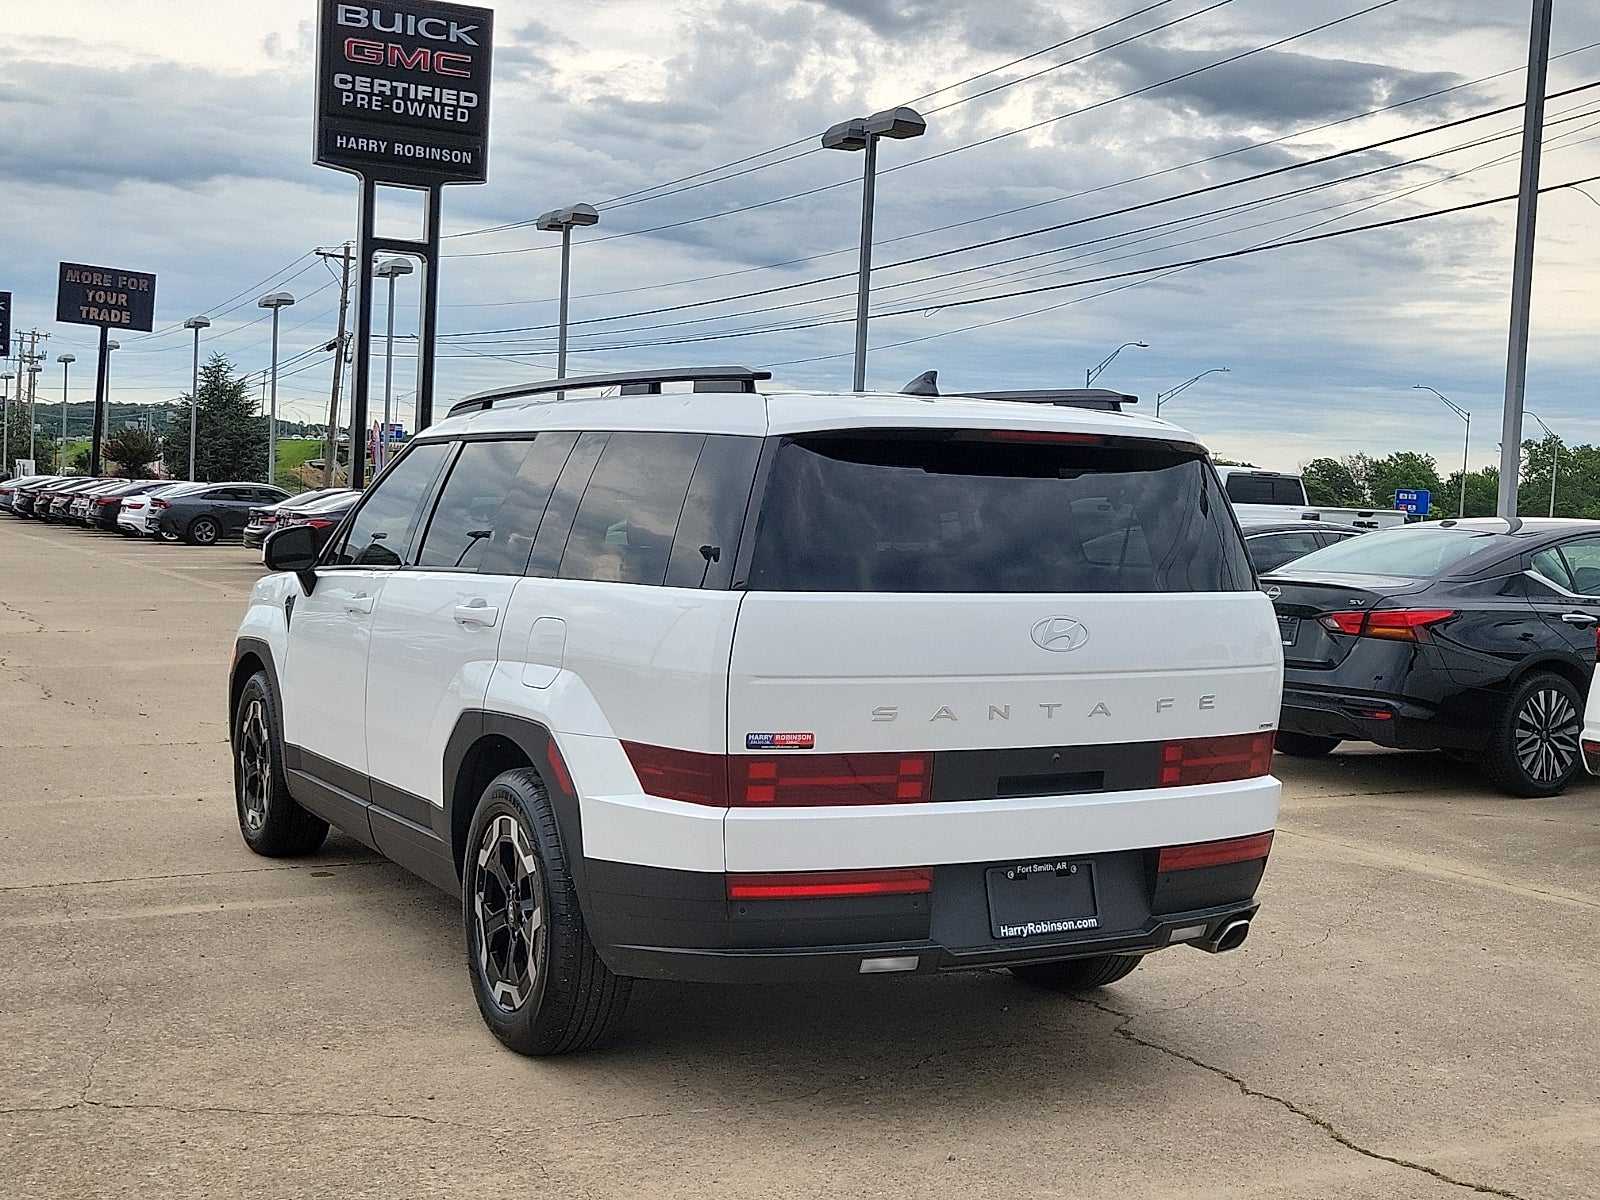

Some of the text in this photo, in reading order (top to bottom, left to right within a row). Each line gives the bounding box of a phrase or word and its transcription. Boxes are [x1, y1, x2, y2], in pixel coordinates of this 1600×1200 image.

[337, 4, 479, 47] BUICK
[344, 38, 471, 78] GMC
[334, 73, 478, 107] CERTIFIED
[342, 91, 469, 123] PRE-OWNED
[336, 135, 472, 164] HARRY ROBINSON
[65, 269, 149, 292] MORE FOR
[85, 288, 128, 306] YOUR
[79, 305, 131, 324] TRADE
[871, 694, 1216, 722] SANTA FE
[1016, 861, 1067, 874] Fort Smith, AR
[1000, 917, 1098, 938] HarryRobinson.com
